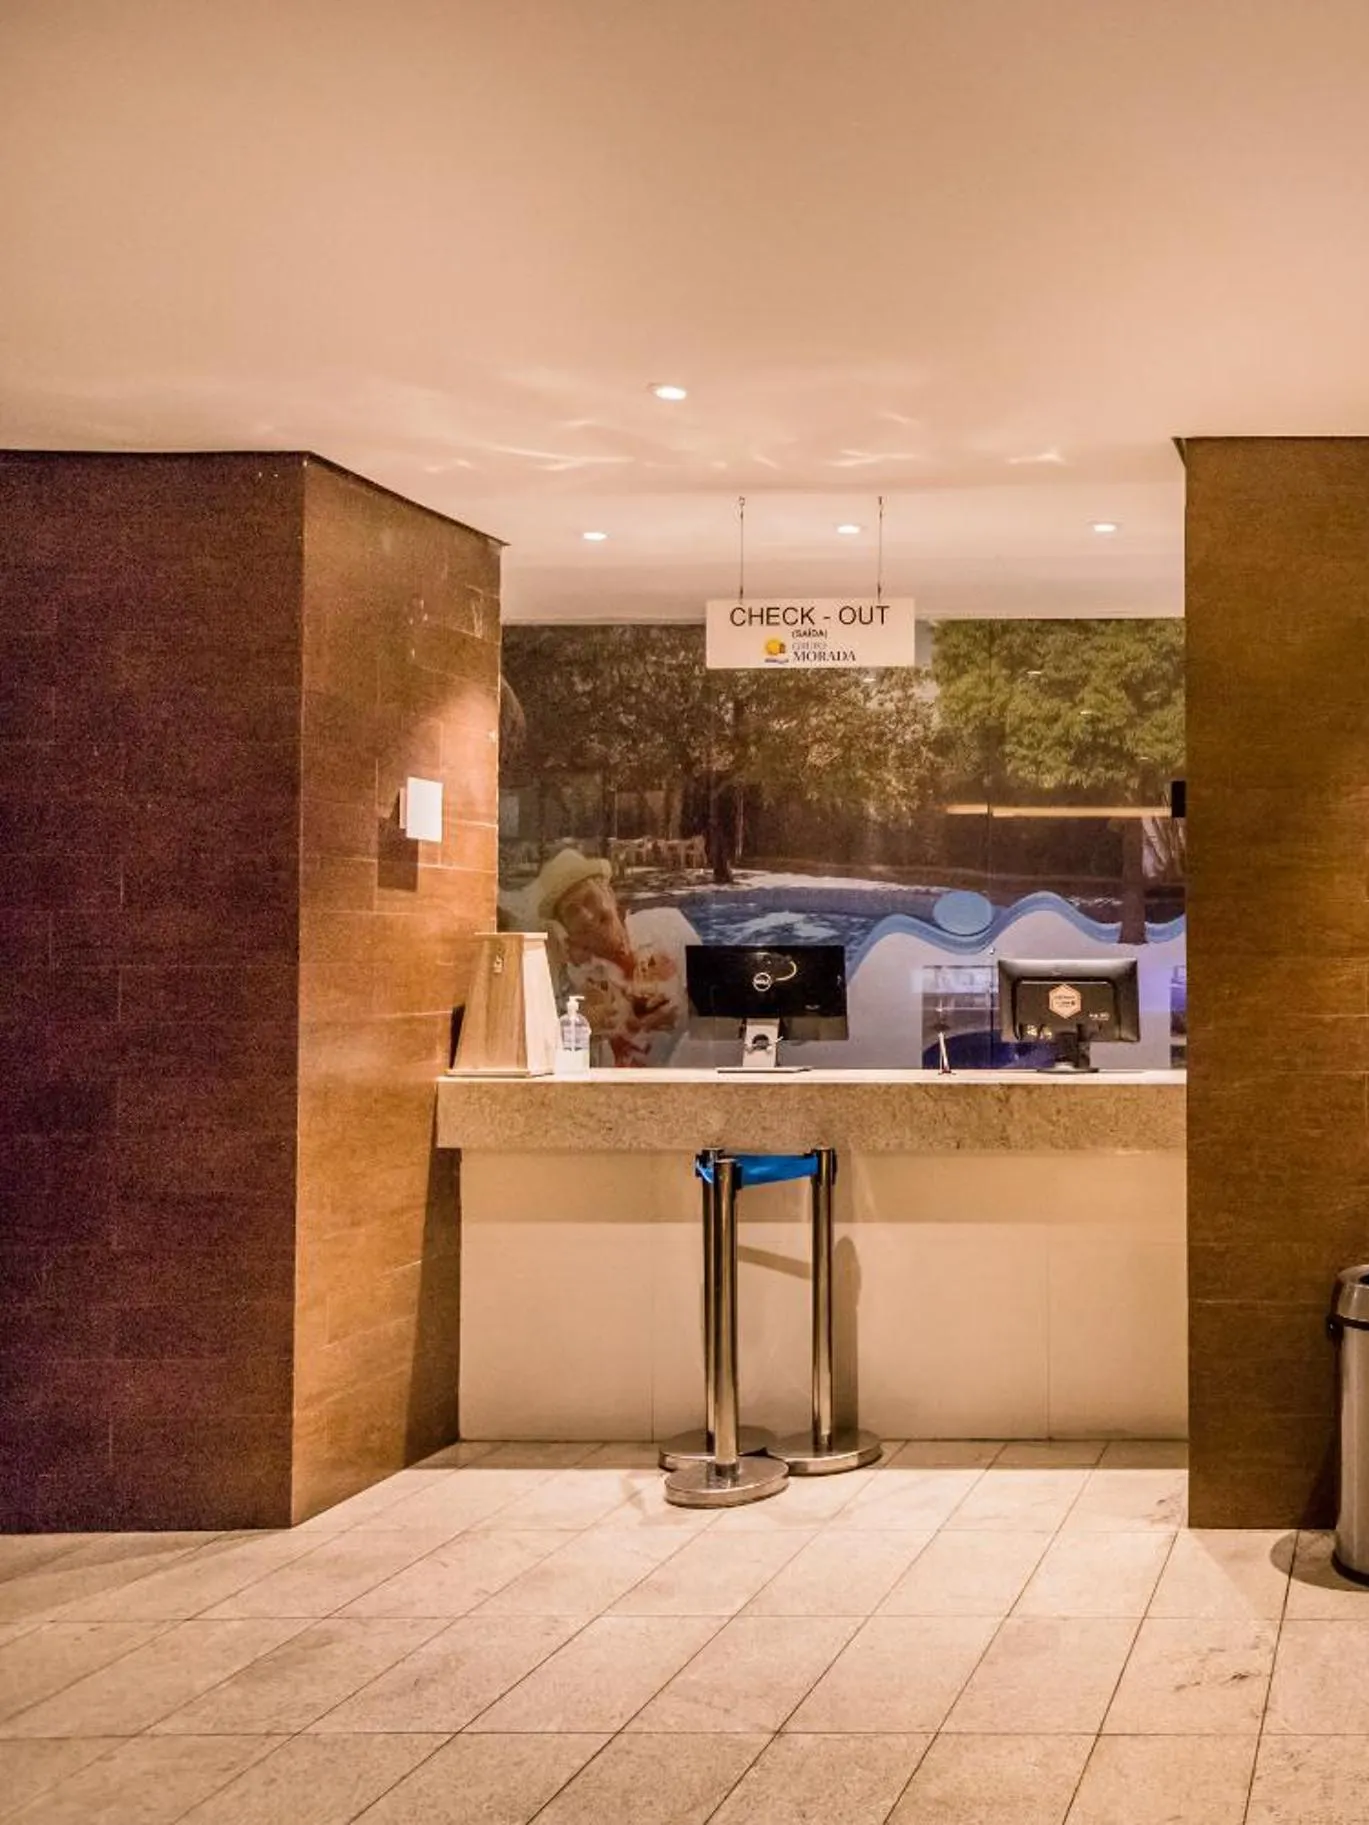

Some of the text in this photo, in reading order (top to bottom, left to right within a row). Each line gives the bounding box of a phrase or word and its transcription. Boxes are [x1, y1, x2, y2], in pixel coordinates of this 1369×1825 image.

[729, 607, 815, 627] CHECK
[838, 605, 890, 625] OUT
[792, 650, 857, 663] MORADA
